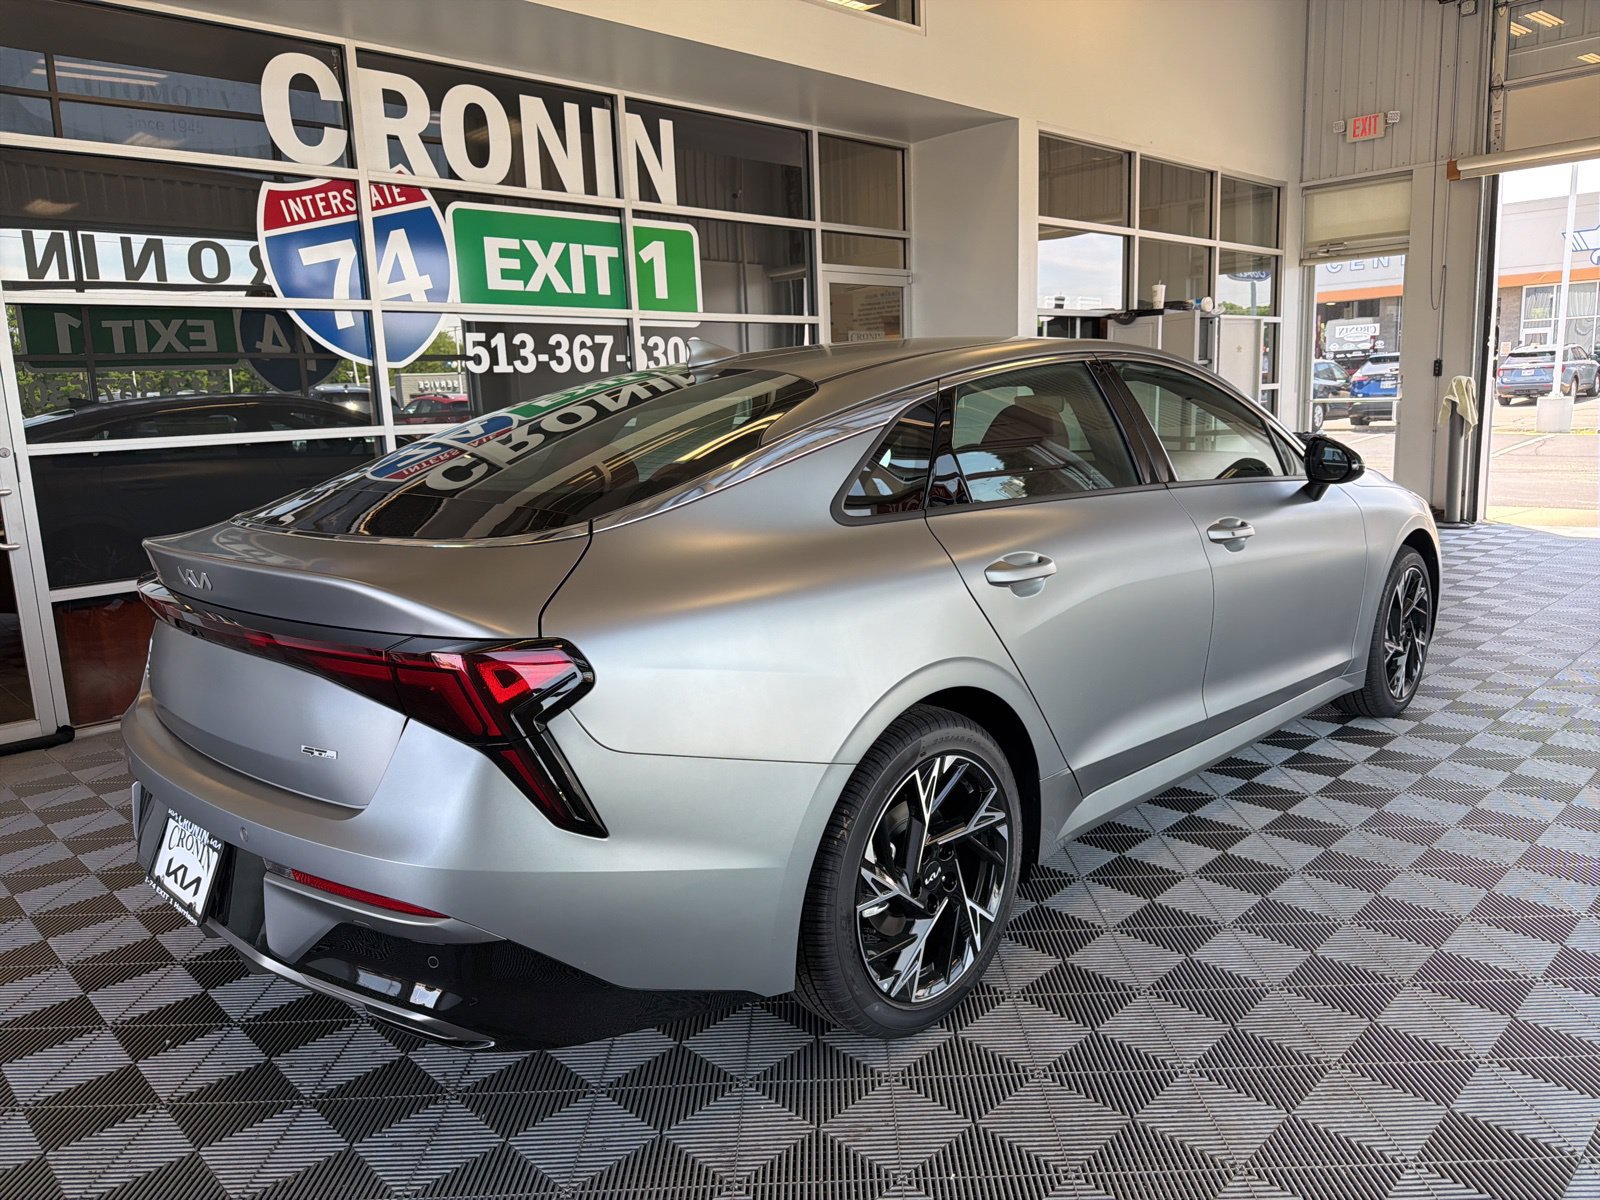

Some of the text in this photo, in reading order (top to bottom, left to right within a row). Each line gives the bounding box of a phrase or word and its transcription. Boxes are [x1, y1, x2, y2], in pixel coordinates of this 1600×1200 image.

[260, 52, 678, 206] CRONIN
[1353, 114, 1379, 138] EXIT
[280, 183, 406, 223] INTERSATE
[299, 228, 433, 330] 74
[483, 236, 668, 300] EXIT 1
[465, 332, 700, 374] 513-367-530
[168, 824, 217, 878] CRONIN
[165, 857, 202, 898] KIA
[173, 900, 198, 926] Harrison
